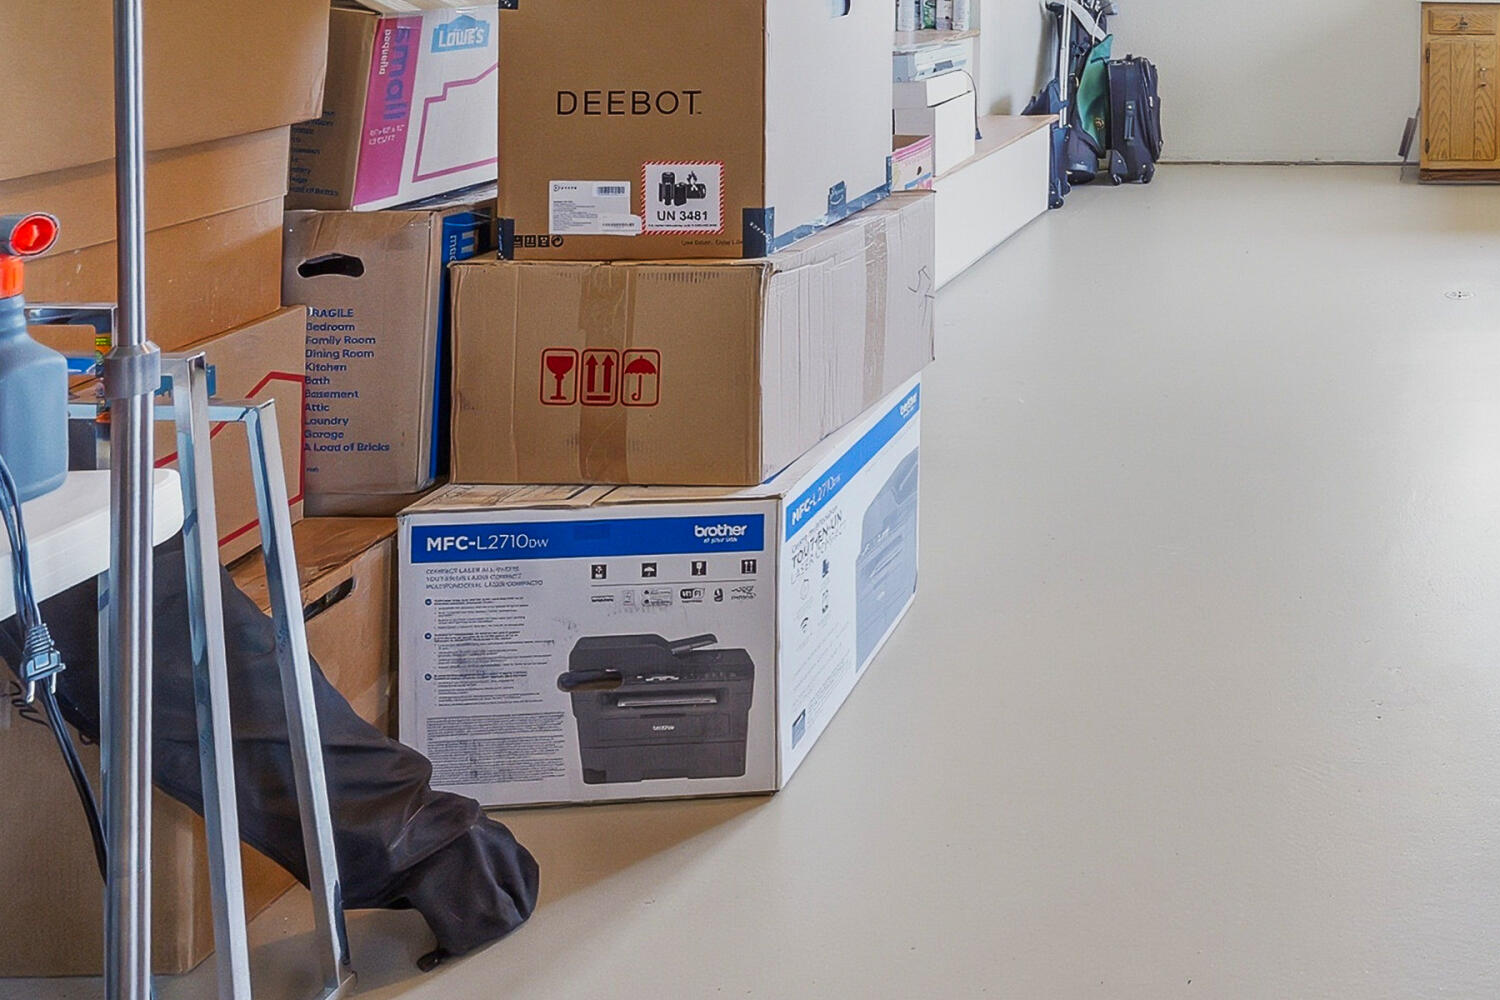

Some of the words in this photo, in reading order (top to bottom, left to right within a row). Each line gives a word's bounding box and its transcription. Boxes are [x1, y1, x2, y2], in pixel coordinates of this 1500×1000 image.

[384, 27, 410, 119] small
[557, 90, 702, 115] DEEBOT
[657, 210, 676, 221] UN
[680, 210, 708, 221] 3481
[306, 322, 355, 331] Bedroom
[306, 336, 341, 345] Family
[344, 336, 376, 344] Room
[305, 349, 340, 359] Dining
[343, 349, 375, 358] Room
[305, 362, 347, 371] Kitchen
[304, 376, 329, 385] Bath
[304, 403, 330, 411] Attic
[304, 417, 349, 426] Laundry
[304, 430, 344, 440] Garage
[694, 523, 748, 537] brother
[426, 533, 549, 552] MFC-L2710DW
